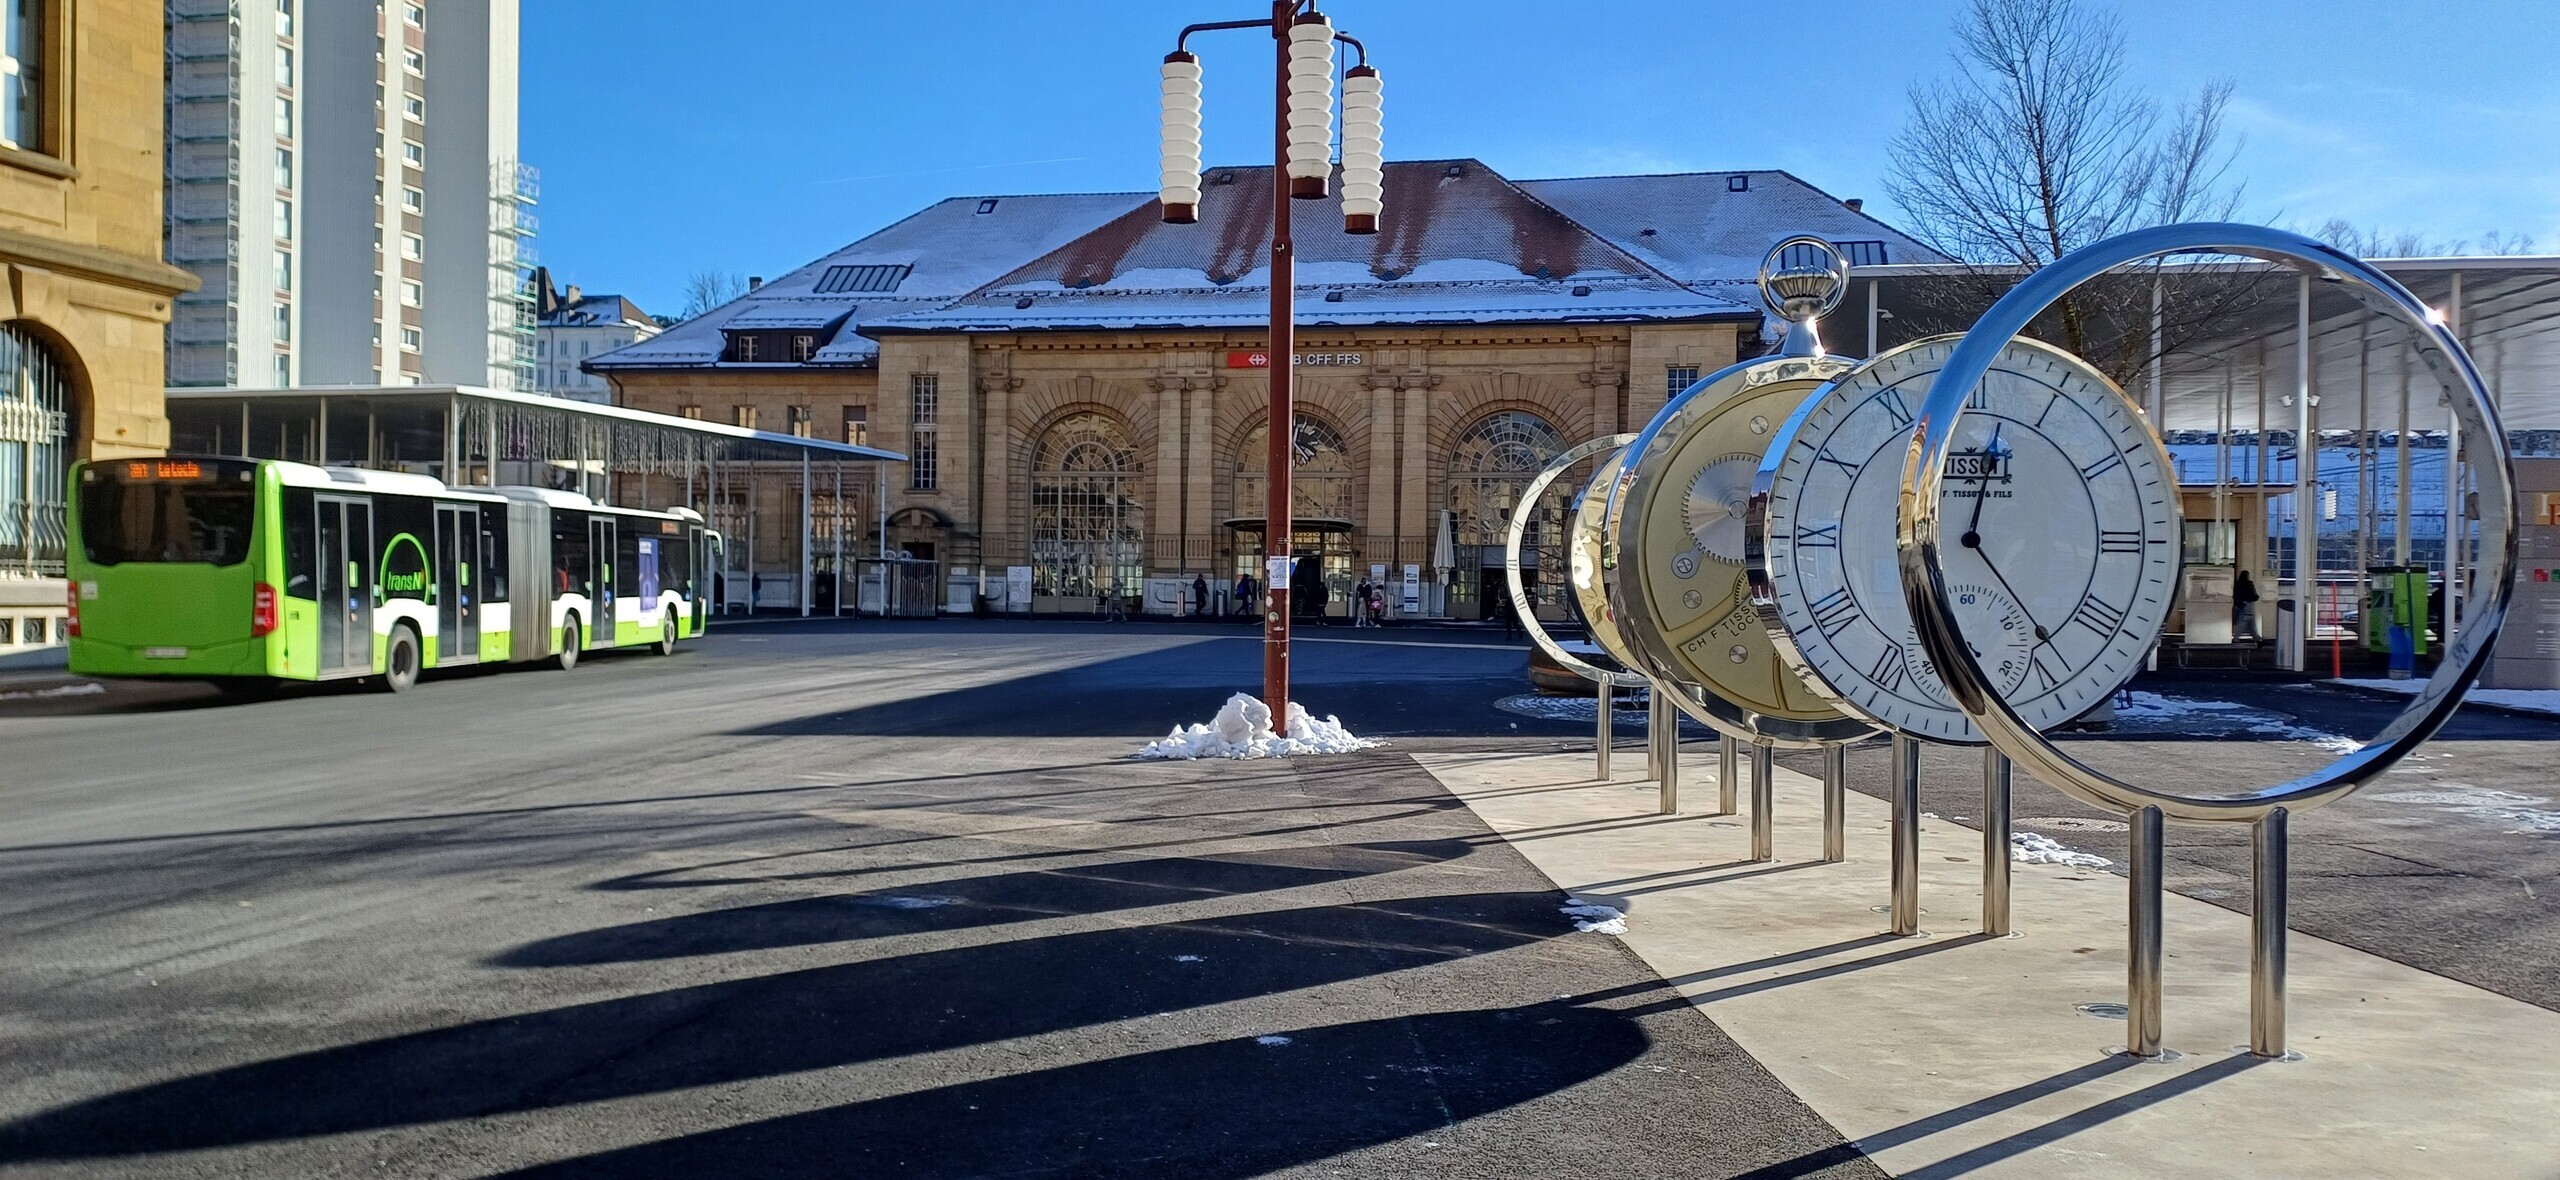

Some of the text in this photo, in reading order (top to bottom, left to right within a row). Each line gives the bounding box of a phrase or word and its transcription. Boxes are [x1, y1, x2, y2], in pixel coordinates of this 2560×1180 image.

[1306, 353, 1332, 365] CFF
[1336, 353, 1361, 365] FFS
[1875, 387, 1914, 432] XI
[2034, 393, 2060, 428] I
[1819, 448, 1860, 480] X
[2081, 451, 2122, 483] II
[1953, 490, 1981, 498] TISSOT
[1985, 490, 1991, 498] &
[1994, 490, 2012, 498] FILS
[1797, 524, 1837, 549] IX
[2101, 529, 2141, 554] III
[1721, 598, 1756, 630] TISSO
[1810, 585, 1860, 640] VIII
[1960, 594, 1976, 605] 60
[1730, 611, 1760, 637] LOCL
[1999, 615, 2014, 631] 10
[2073, 593, 2124, 640] IIII
[1867, 643, 1905, 693] VII
[1921, 660, 1935, 675] 40
[1998, 660, 2013, 677] 20
[2034, 656, 2059, 691] V
